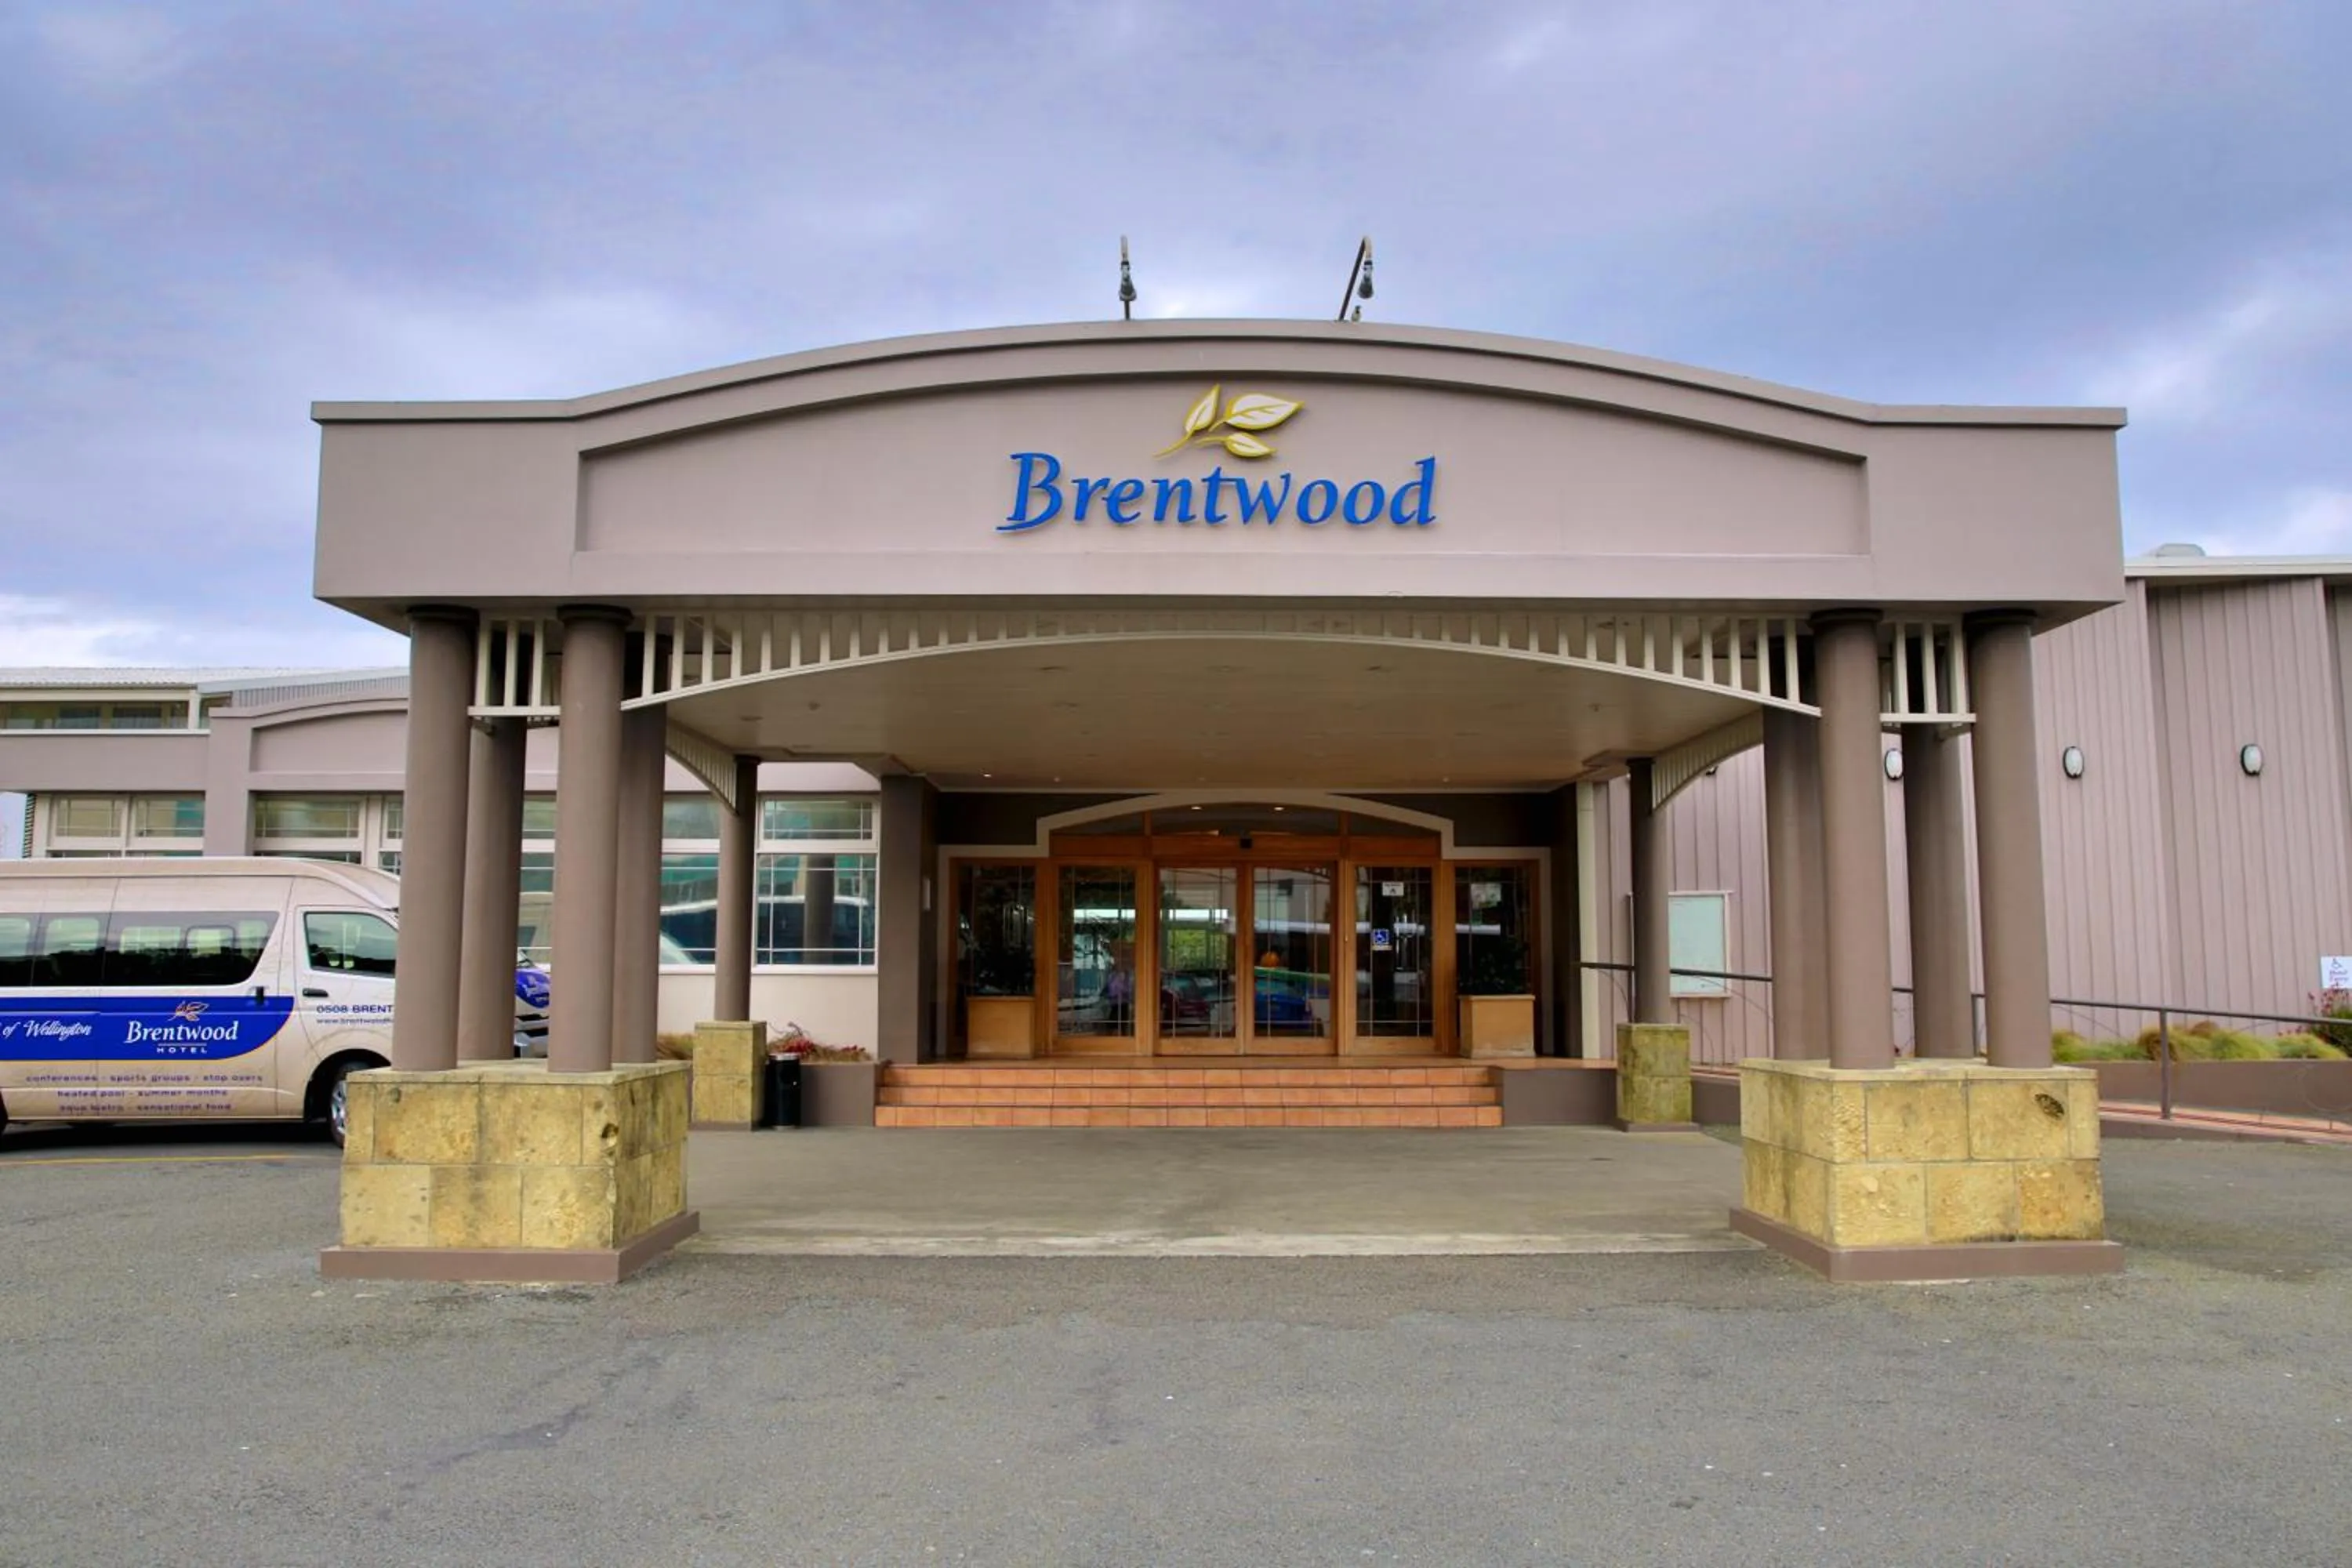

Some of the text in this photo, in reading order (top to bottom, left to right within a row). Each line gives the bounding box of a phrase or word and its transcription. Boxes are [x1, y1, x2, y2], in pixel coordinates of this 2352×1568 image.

[996, 451, 1436, 531] Brentwood
[316, 1004, 394, 1014] 0508 BRENT
[2, 1020, 93, 1042] of Wellington
[122, 1020, 239, 1044] Brentwood
